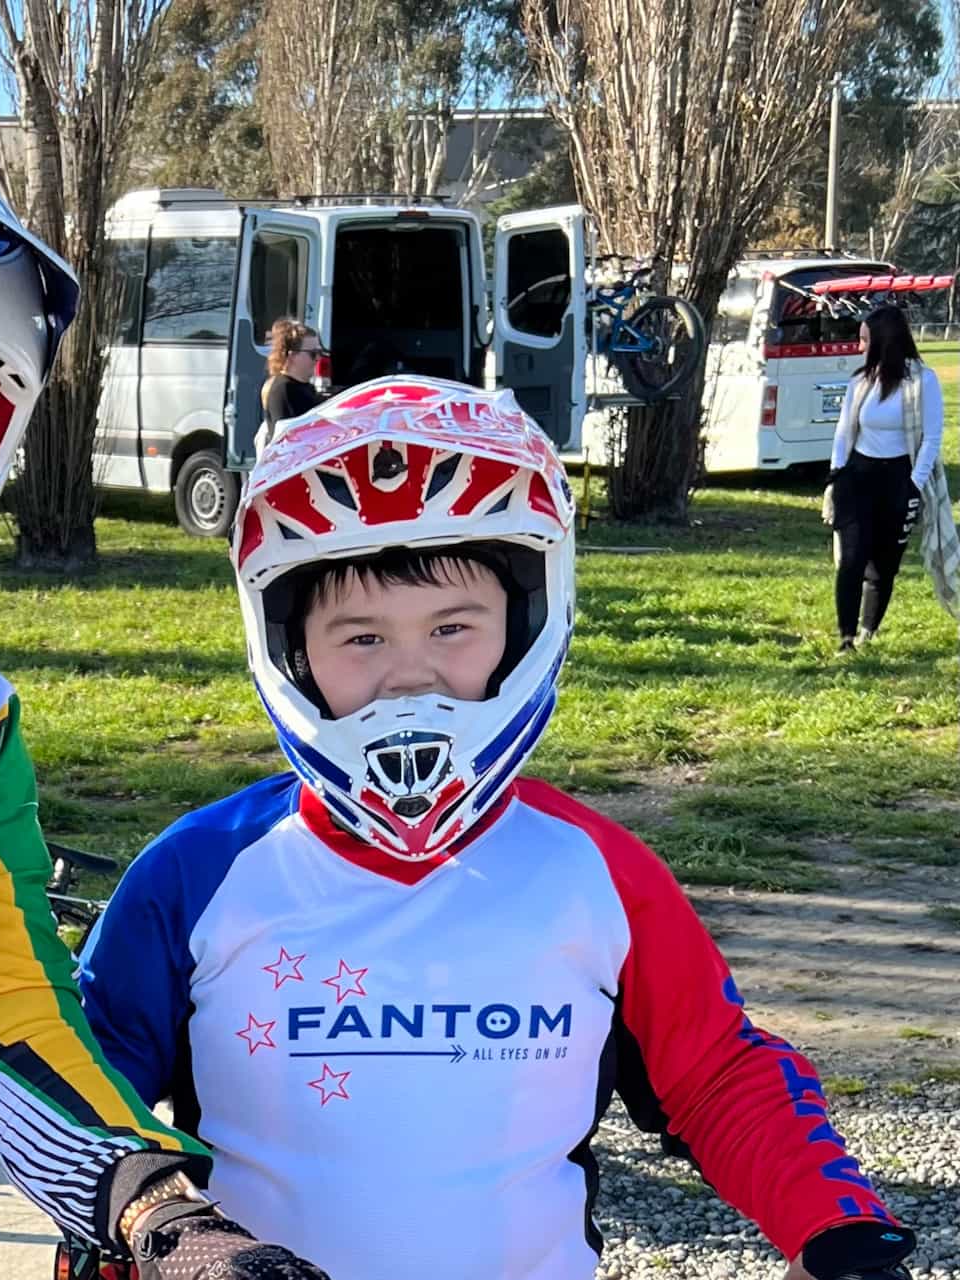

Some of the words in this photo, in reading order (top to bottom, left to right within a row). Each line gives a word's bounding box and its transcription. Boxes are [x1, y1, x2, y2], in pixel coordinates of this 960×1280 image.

[287, 1003, 572, 1041] FANTOM
[472, 1046, 494, 1060] ALL
[500, 1046, 528, 1060] EYES
[535, 1047, 550, 1060] ON
[554, 1046, 568, 1059] US
